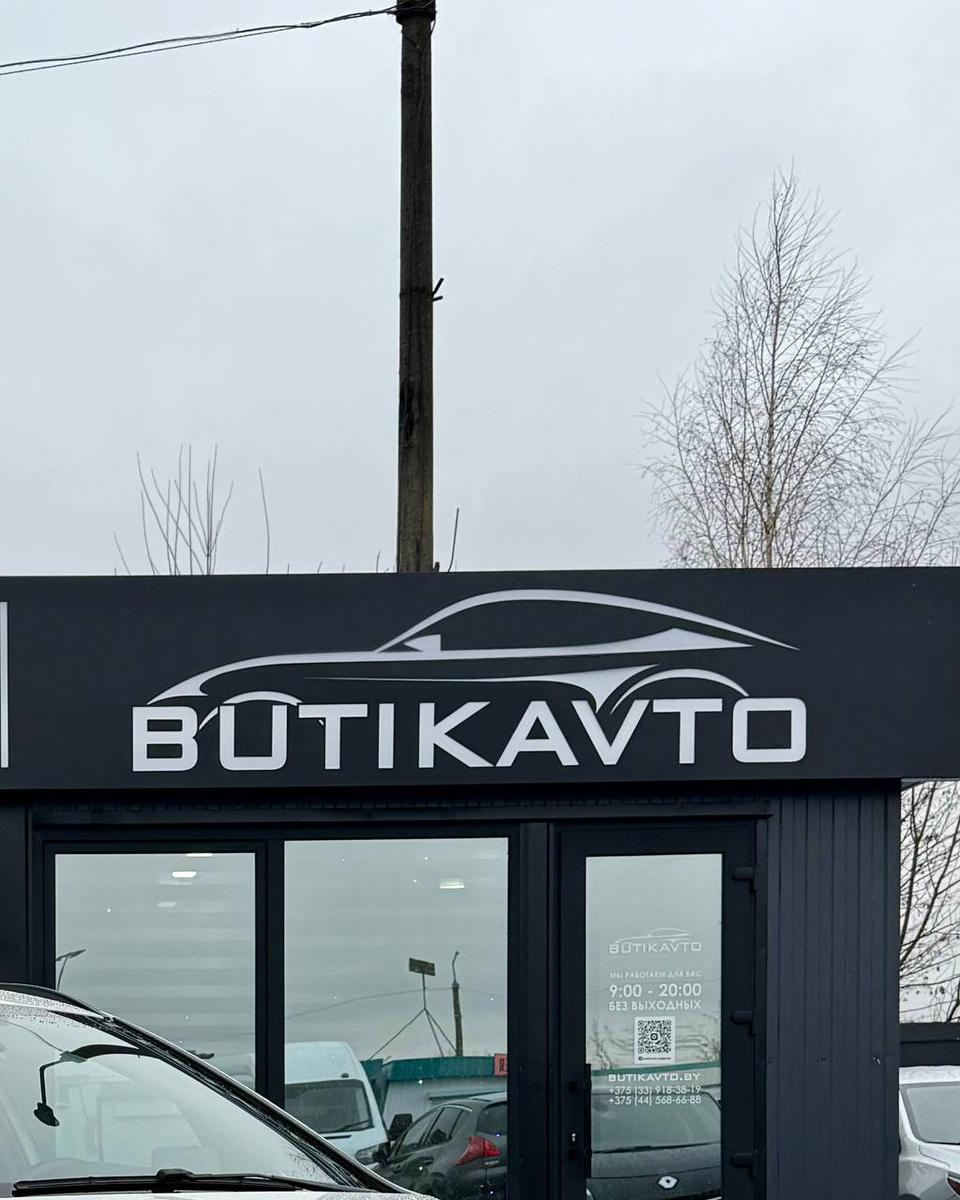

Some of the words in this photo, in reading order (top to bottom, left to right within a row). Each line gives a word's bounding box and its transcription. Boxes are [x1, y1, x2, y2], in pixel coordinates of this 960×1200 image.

[130, 696, 808, 773] BUTIKAVTO
[608, 942, 702, 954] BUTIKAVTO
[609, 971, 624, 979] МЫ
[667, 970, 684, 978] ДЛЯ
[685, 969, 703, 978] ВАС
[609, 983, 642, 998] 9:00
[659, 982, 702, 997] 20:00
[609, 1001, 628, 1011] БЕЗ
[631, 1000, 702, 1012] ВЫХОДНЫХ
[608, 1072, 701, 1082] BUTIKAVTO.BY
[608, 1085, 632, 1095] +375
[608, 1095, 632, 1105] +375
[655, 1094, 702, 1105] 568-66-88
